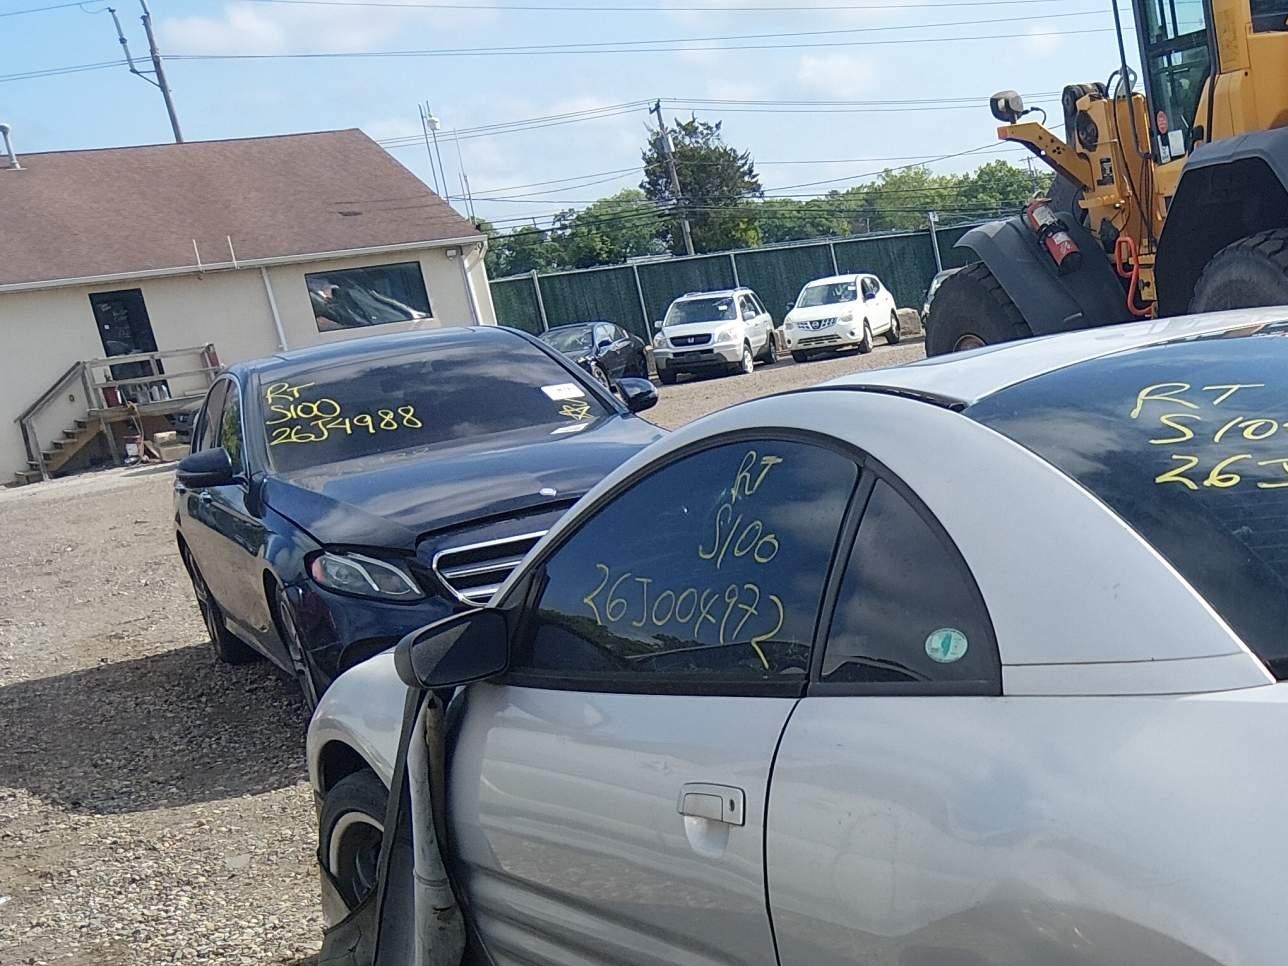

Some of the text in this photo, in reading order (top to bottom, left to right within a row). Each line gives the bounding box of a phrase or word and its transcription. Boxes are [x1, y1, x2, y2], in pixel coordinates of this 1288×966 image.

[265, 398, 341, 425] S100
[266, 382, 316, 404] RT
[1130, 382, 1265, 418] RT
[270, 405, 423, 446] 26J4988
[732, 449, 784, 504] RT
[698, 503, 780, 569] S100
[583, 564, 784, 670] 26J004972
